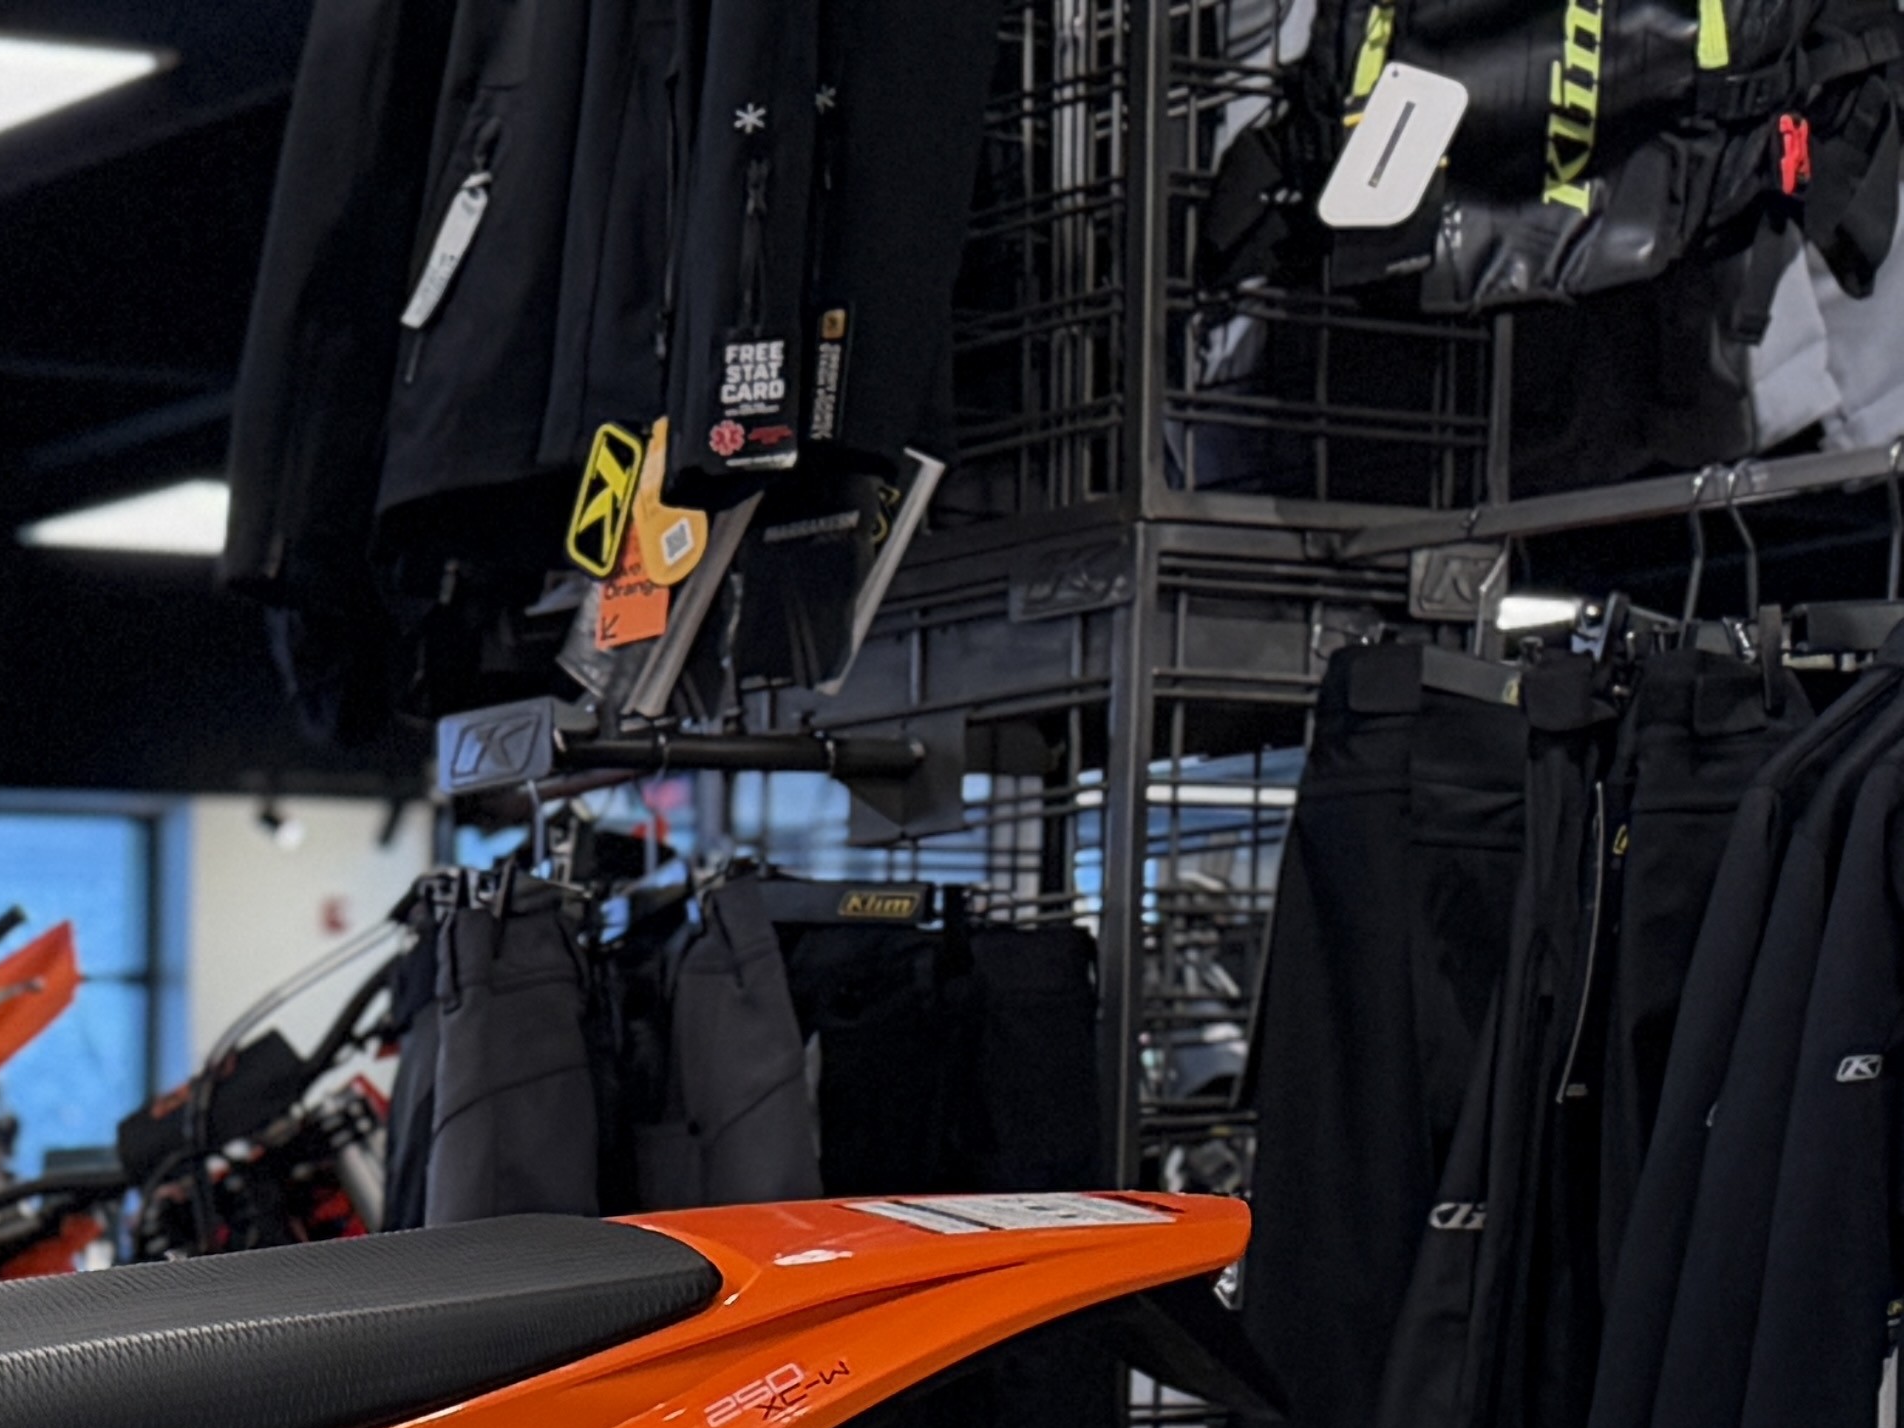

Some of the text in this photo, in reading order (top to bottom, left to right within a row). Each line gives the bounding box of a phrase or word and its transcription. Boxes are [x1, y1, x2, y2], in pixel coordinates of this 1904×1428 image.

[724, 340, 785, 364] FREE
[725, 360, 783, 385] STAT
[720, 379, 785, 404] CARD
[703, 1362, 805, 1428] 250
[756, 1360, 851, 1421] XC-W
